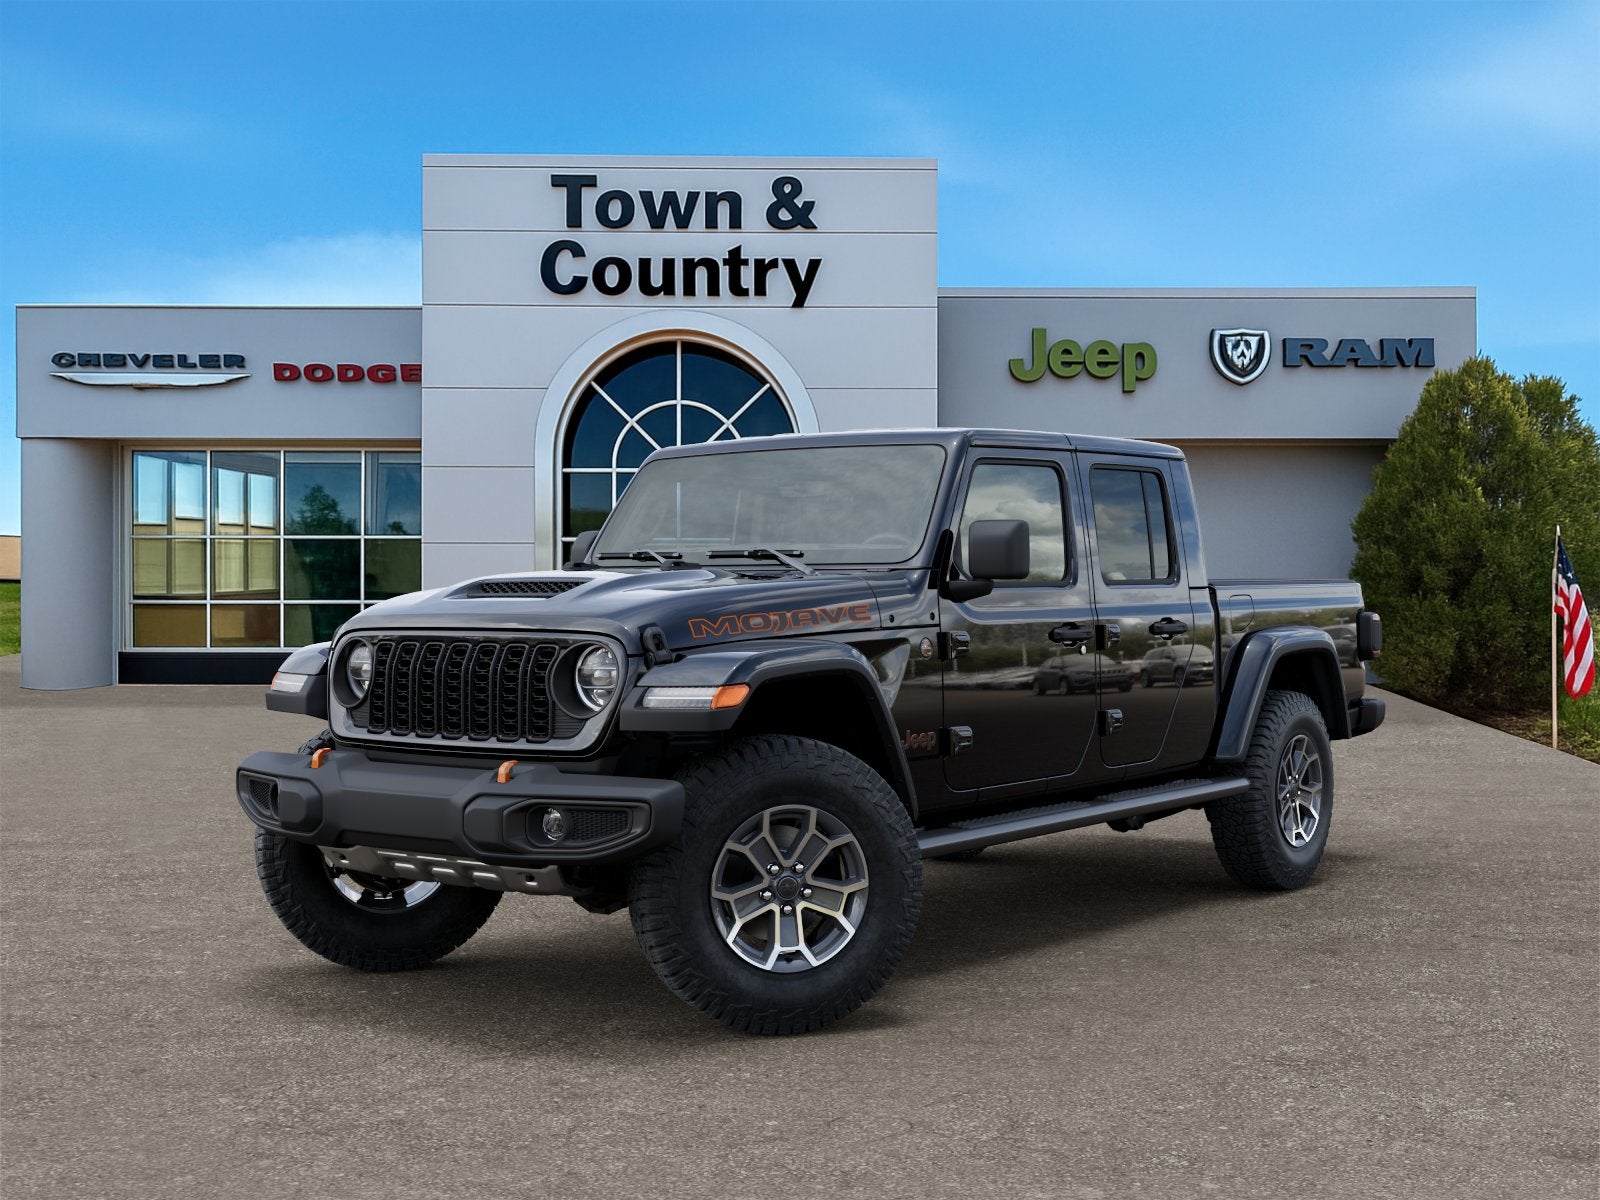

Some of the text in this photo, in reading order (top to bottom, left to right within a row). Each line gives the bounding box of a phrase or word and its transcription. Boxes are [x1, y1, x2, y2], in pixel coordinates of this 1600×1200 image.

[551, 174, 817, 230] Town &
[540, 239, 822, 308] Country
[1009, 328, 1157, 393] Jeep
[1283, 337, 1435, 368] RAM
[273, 362, 422, 383] DODGE
[688, 604, 872, 639] MOJAVE
[900, 729, 936, 752] Jeep
